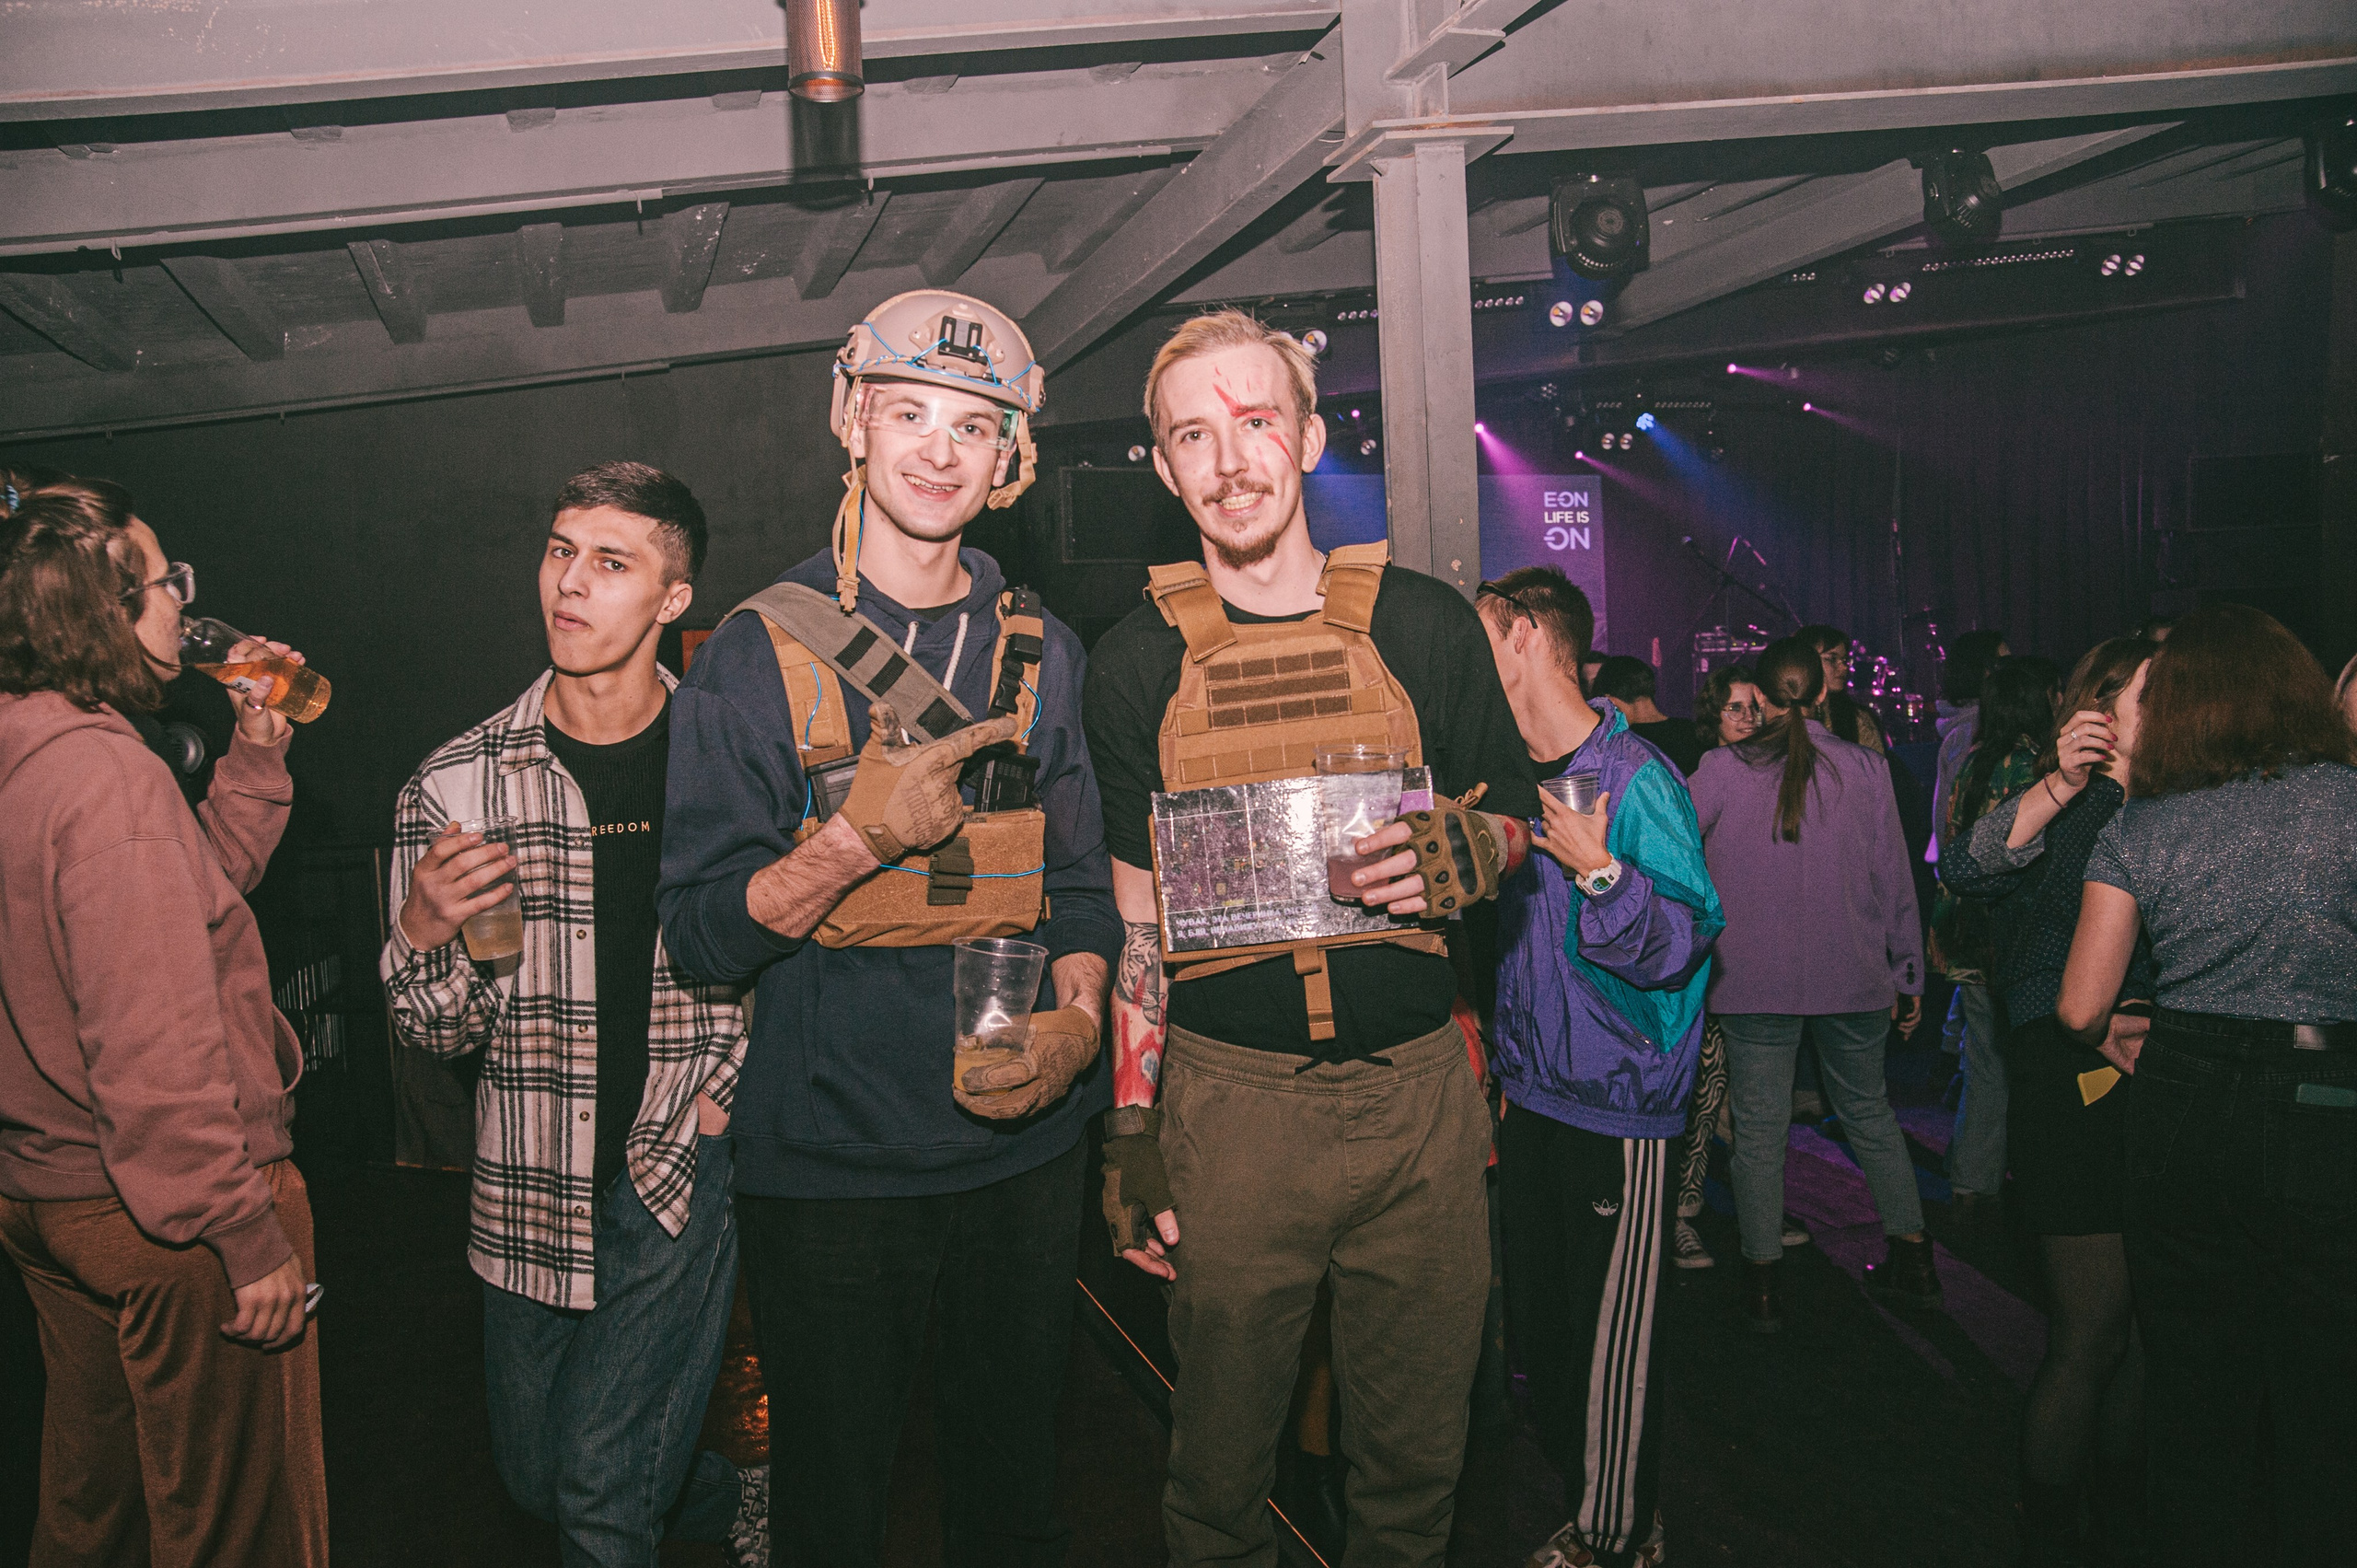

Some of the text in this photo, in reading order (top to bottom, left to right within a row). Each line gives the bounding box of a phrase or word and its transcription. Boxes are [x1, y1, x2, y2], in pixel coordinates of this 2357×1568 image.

[1543, 511, 1590, 524] LIFE IS
[1543, 526, 1591, 551] ON
[590, 820, 650, 837] REEDOM
